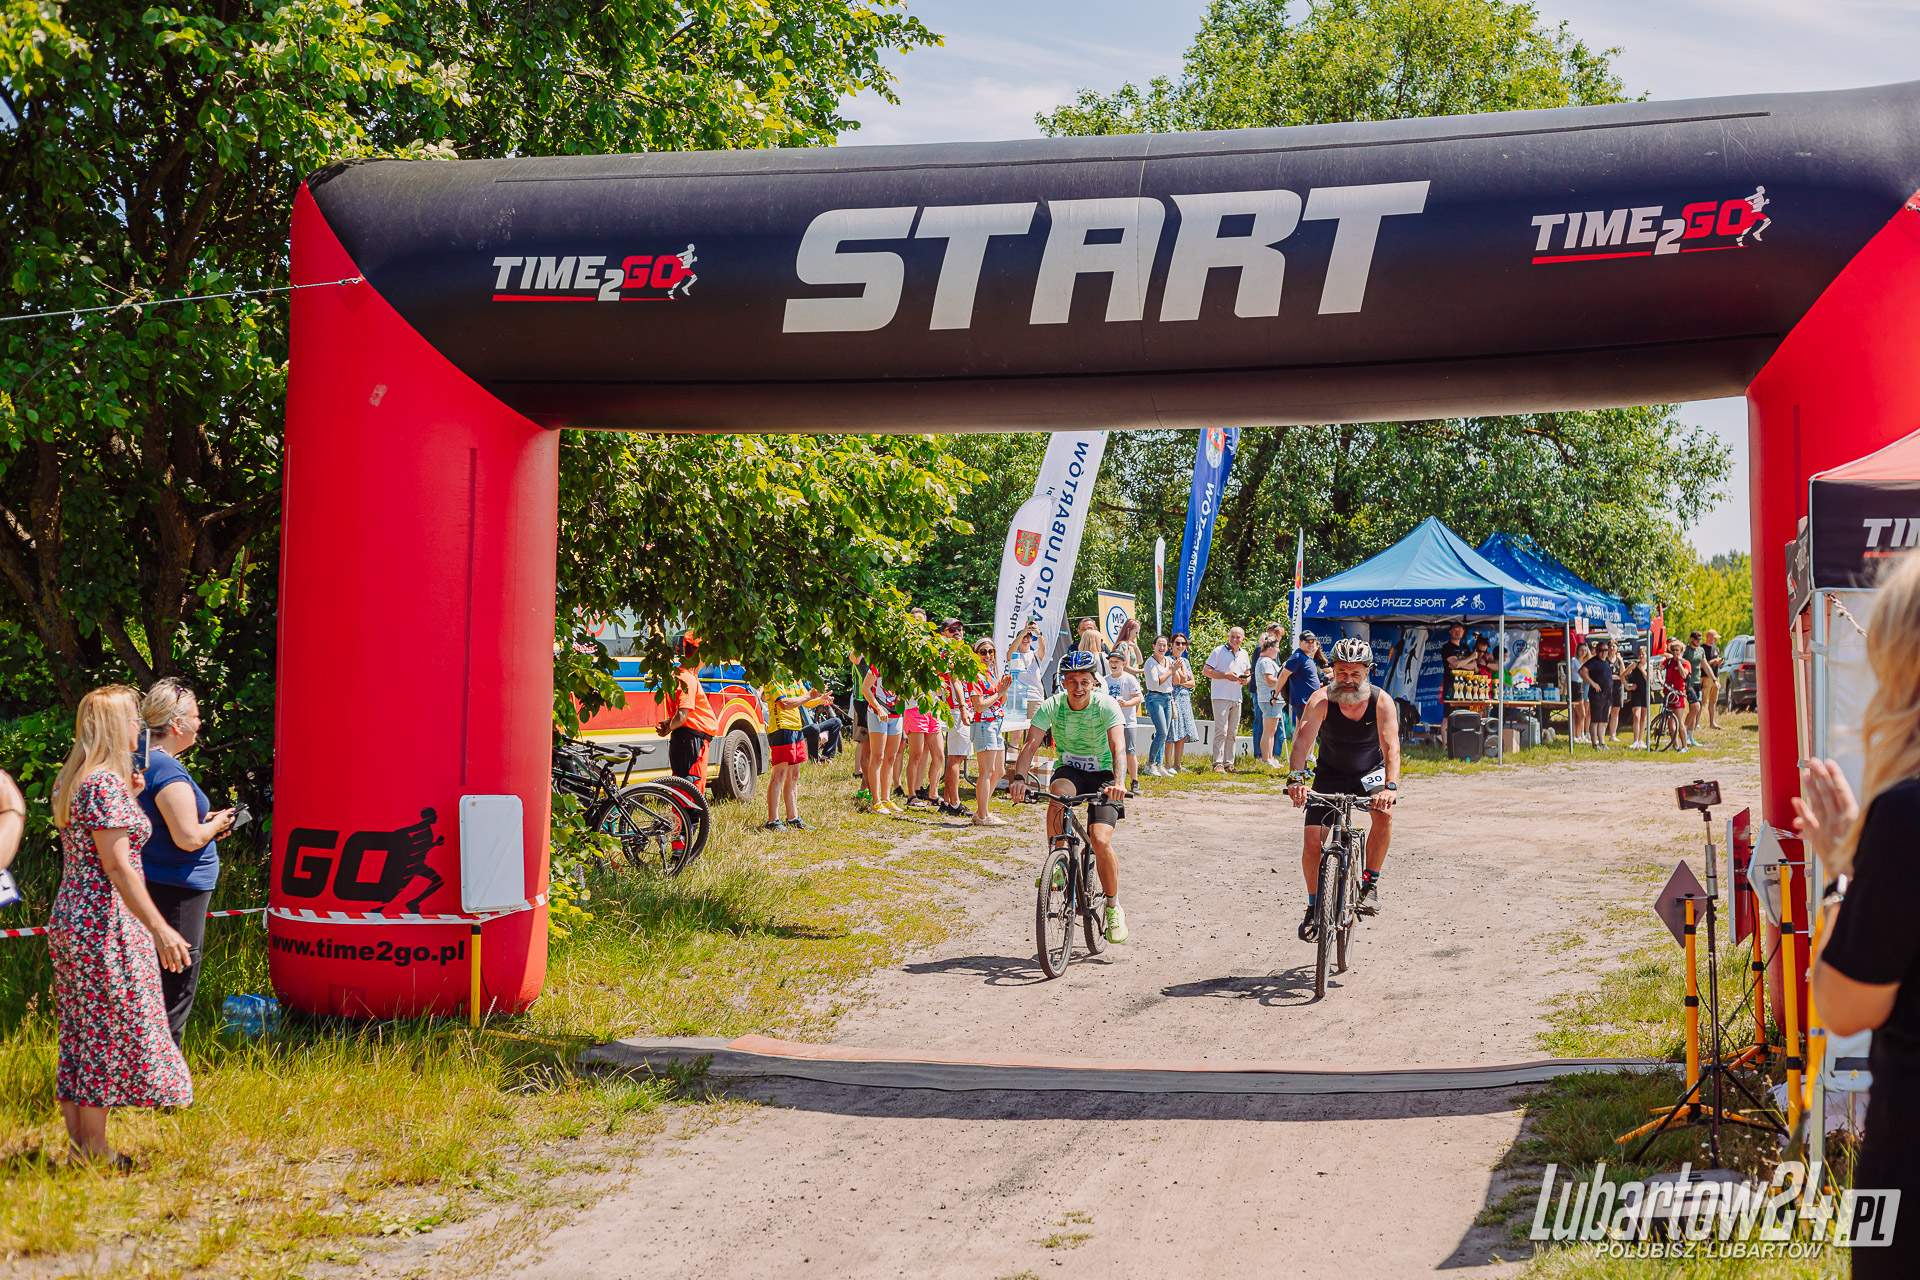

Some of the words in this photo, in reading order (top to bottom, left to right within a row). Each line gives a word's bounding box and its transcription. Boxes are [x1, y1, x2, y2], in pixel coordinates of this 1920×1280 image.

[1531, 199, 1752, 256] TIME2GO
[492, 255, 681, 301] TIME2GO
[783, 180, 1430, 333] START
[1008, 574, 1026, 639] Lubartów
[1339, 596, 1380, 609] RADOŚĆ
[1381, 597, 1412, 608] PRZEZ
[1414, 597, 1447, 608] SPORT
[1203, 725, 1209, 745] 1
[1366, 775, 1383, 784] 30
[281, 827, 402, 902] GO
[271, 935, 465, 967] www.time2go.pl
